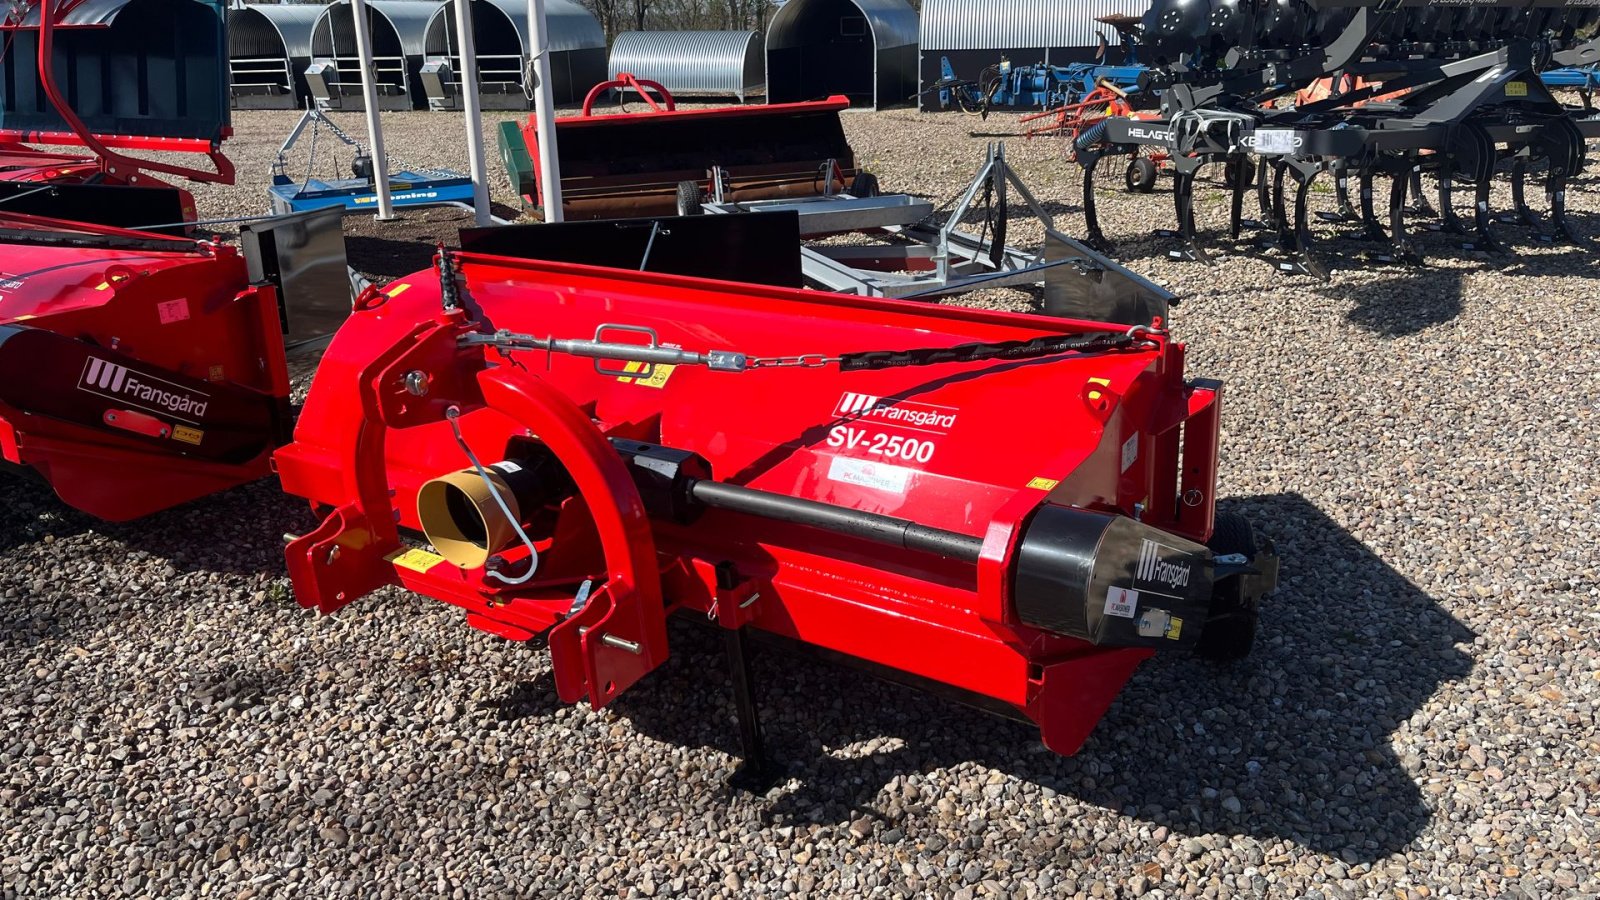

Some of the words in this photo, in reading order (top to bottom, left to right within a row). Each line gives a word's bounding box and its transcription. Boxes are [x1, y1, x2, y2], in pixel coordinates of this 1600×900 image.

[122, 377, 208, 417] Fransgård
[873, 402, 956, 428] Fransgård
[826, 425, 935, 463] SV-2500
[1153, 556, 1191, 589] Fransgård
